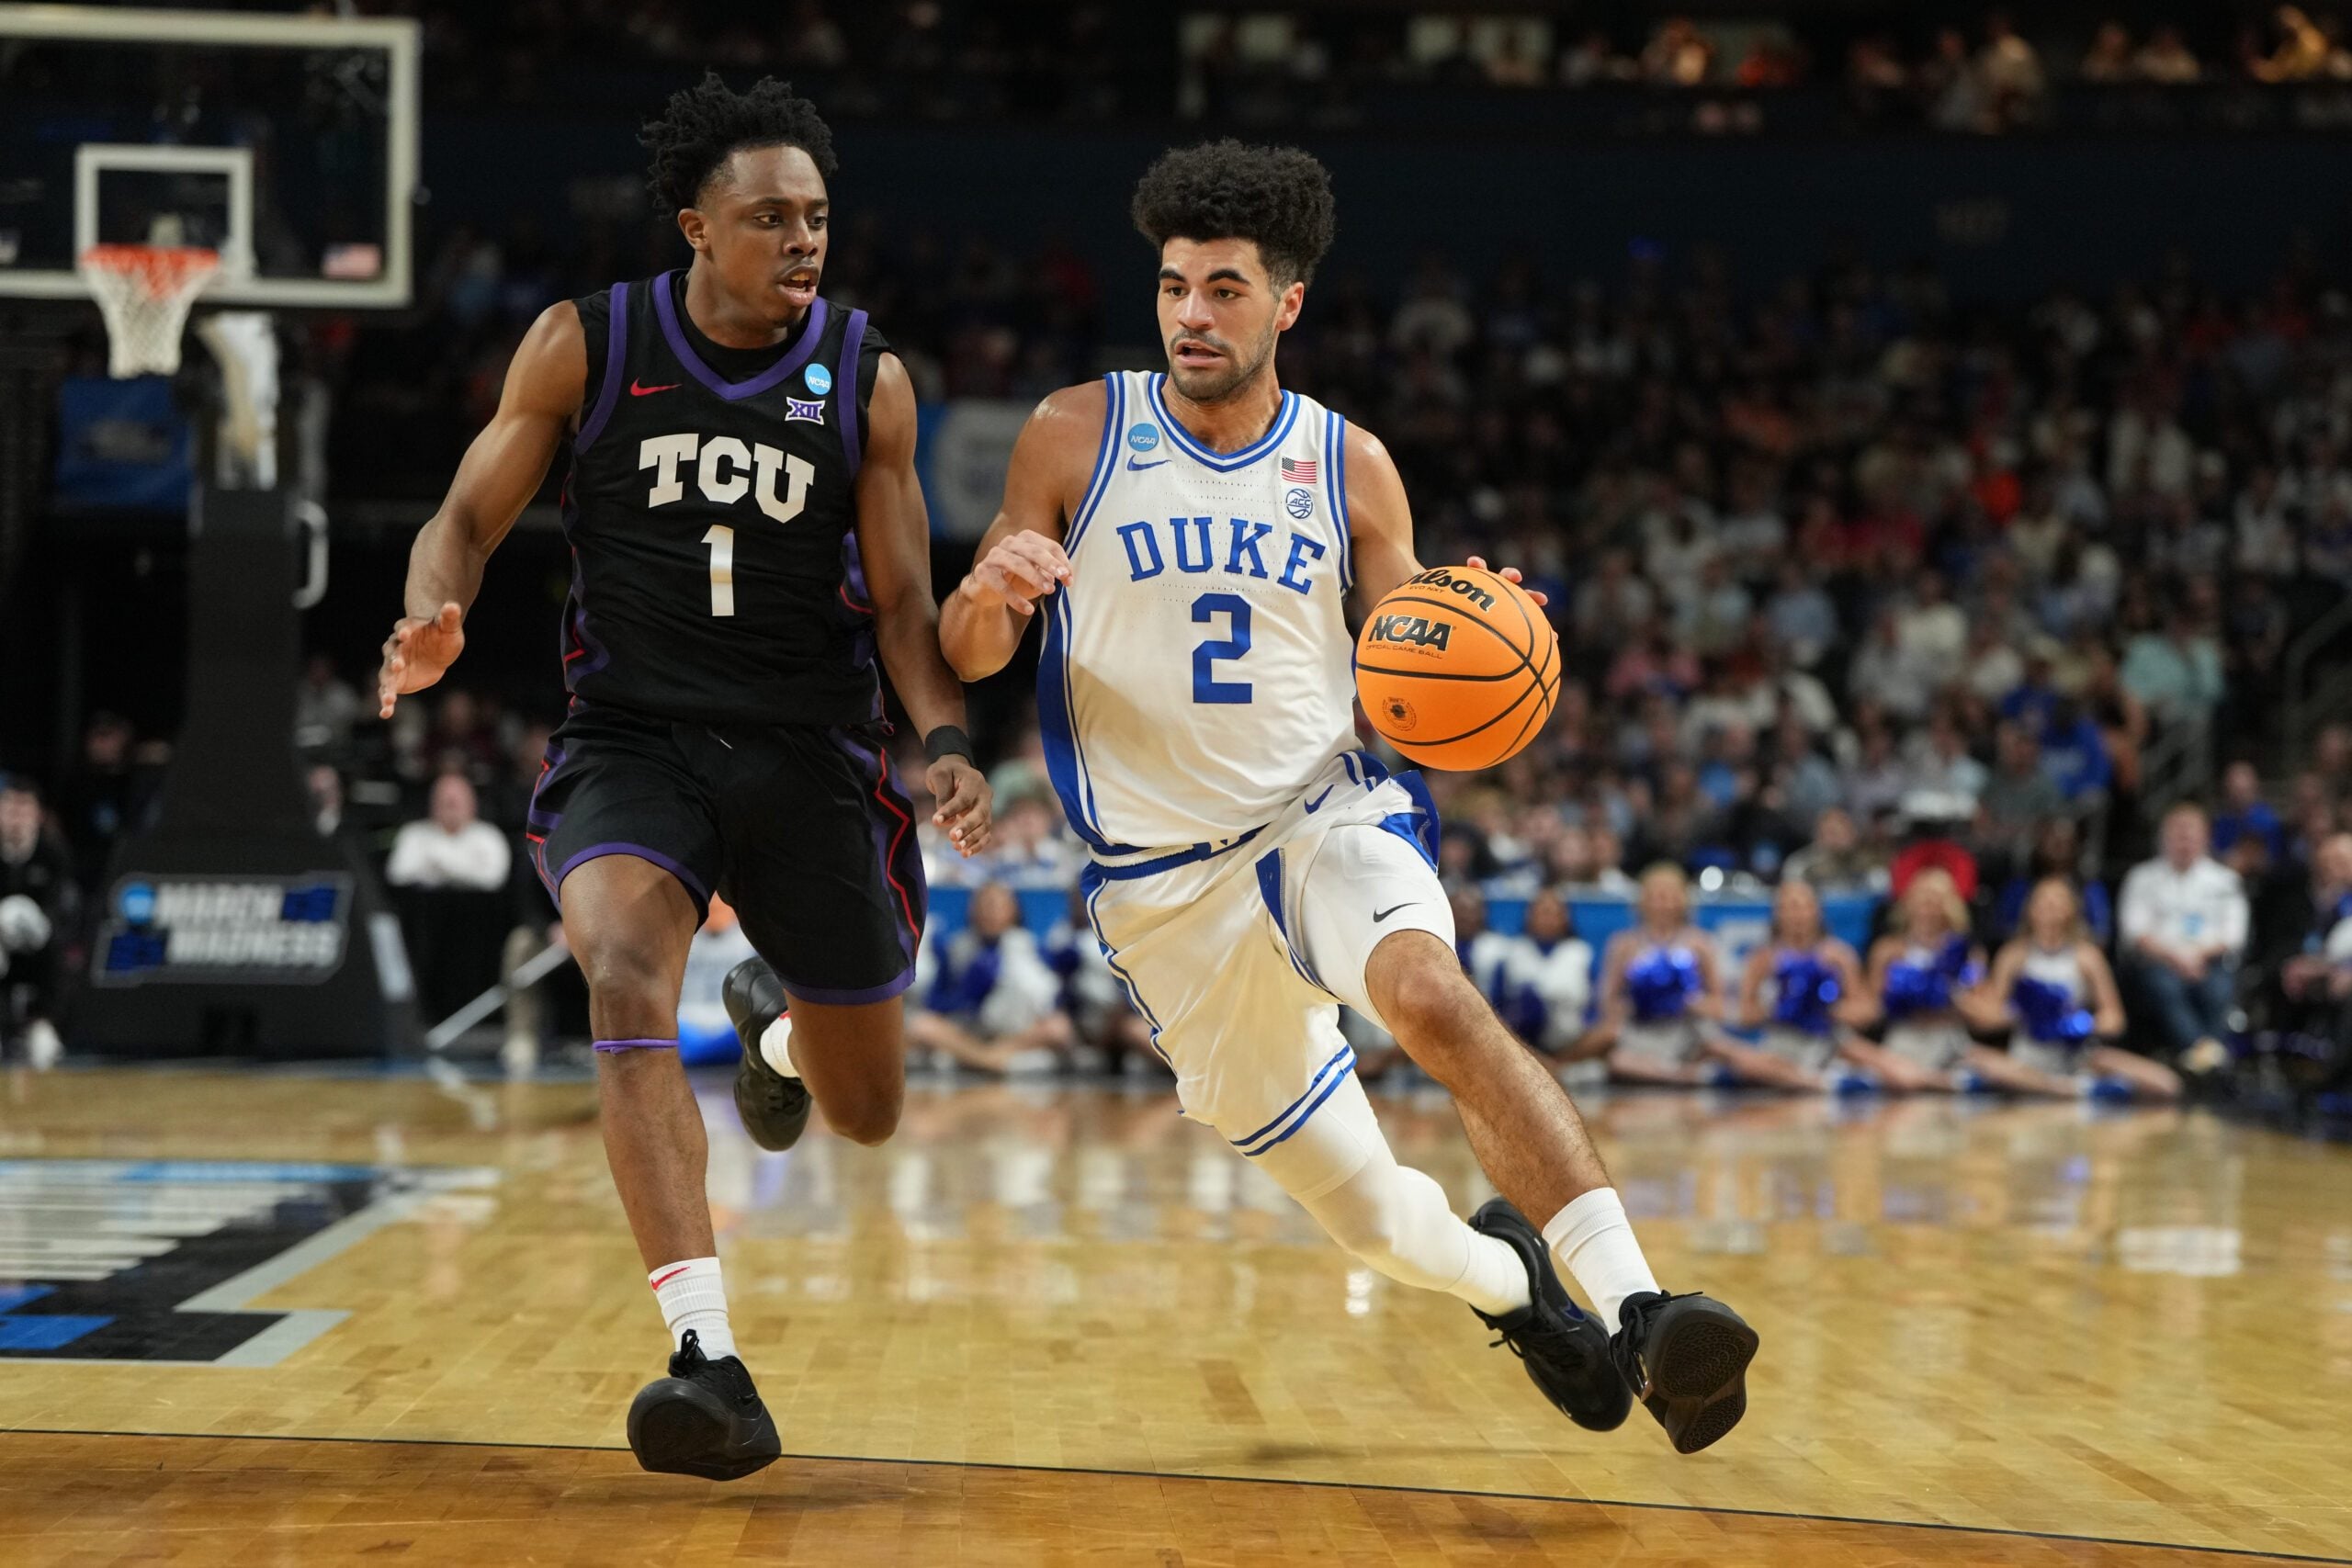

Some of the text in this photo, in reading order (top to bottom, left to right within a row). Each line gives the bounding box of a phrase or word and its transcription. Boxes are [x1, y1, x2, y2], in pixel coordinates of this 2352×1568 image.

[808, 375, 831, 389] NCAA
[787, 399, 824, 422] XII
[1130, 434, 1156, 446] NCAA
[639, 433, 816, 524] TCU
[1290, 498, 1312, 507] ACC
[700, 524, 735, 617] 1
[1116, 516, 1327, 596] DUKE
[1396, 569, 1495, 613] ilson
[1191, 592, 1253, 705] 2
[1367, 614, 1453, 652] NCAA
[1418, 649, 1443, 660] BALL
